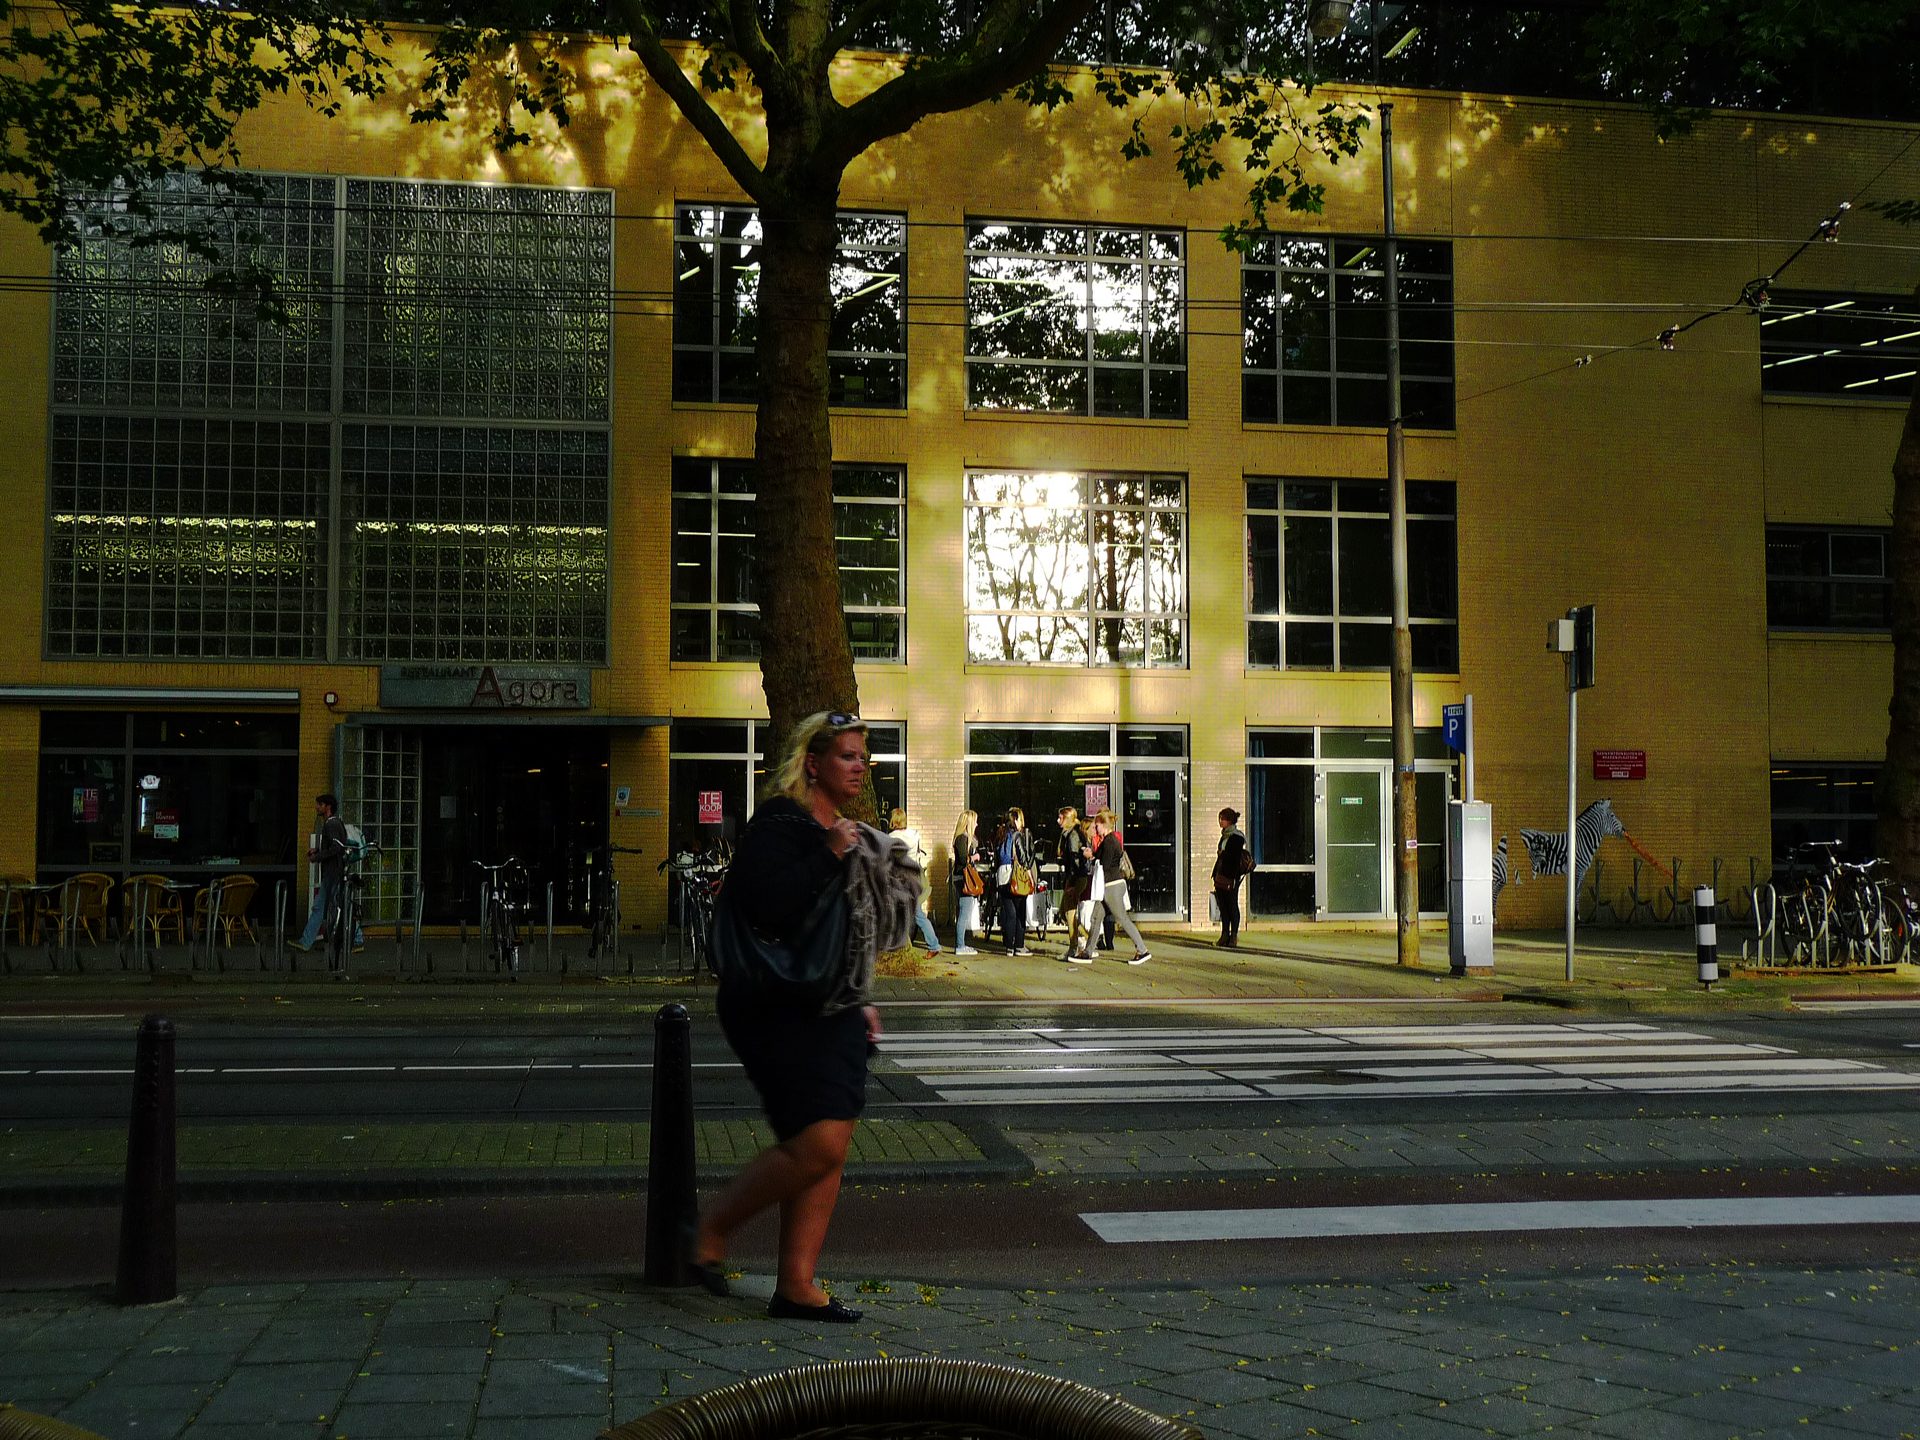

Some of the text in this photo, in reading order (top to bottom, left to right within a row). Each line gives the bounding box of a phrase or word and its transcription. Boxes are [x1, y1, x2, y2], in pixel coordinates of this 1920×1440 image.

[470, 665, 579, 708] Agora
[1449, 718, 1458, 738] P
[83, 788, 98, 797] TE
[1087, 785, 1106, 798] TE
[700, 792, 720, 805] TE
[699, 804, 722, 812] KOOP
